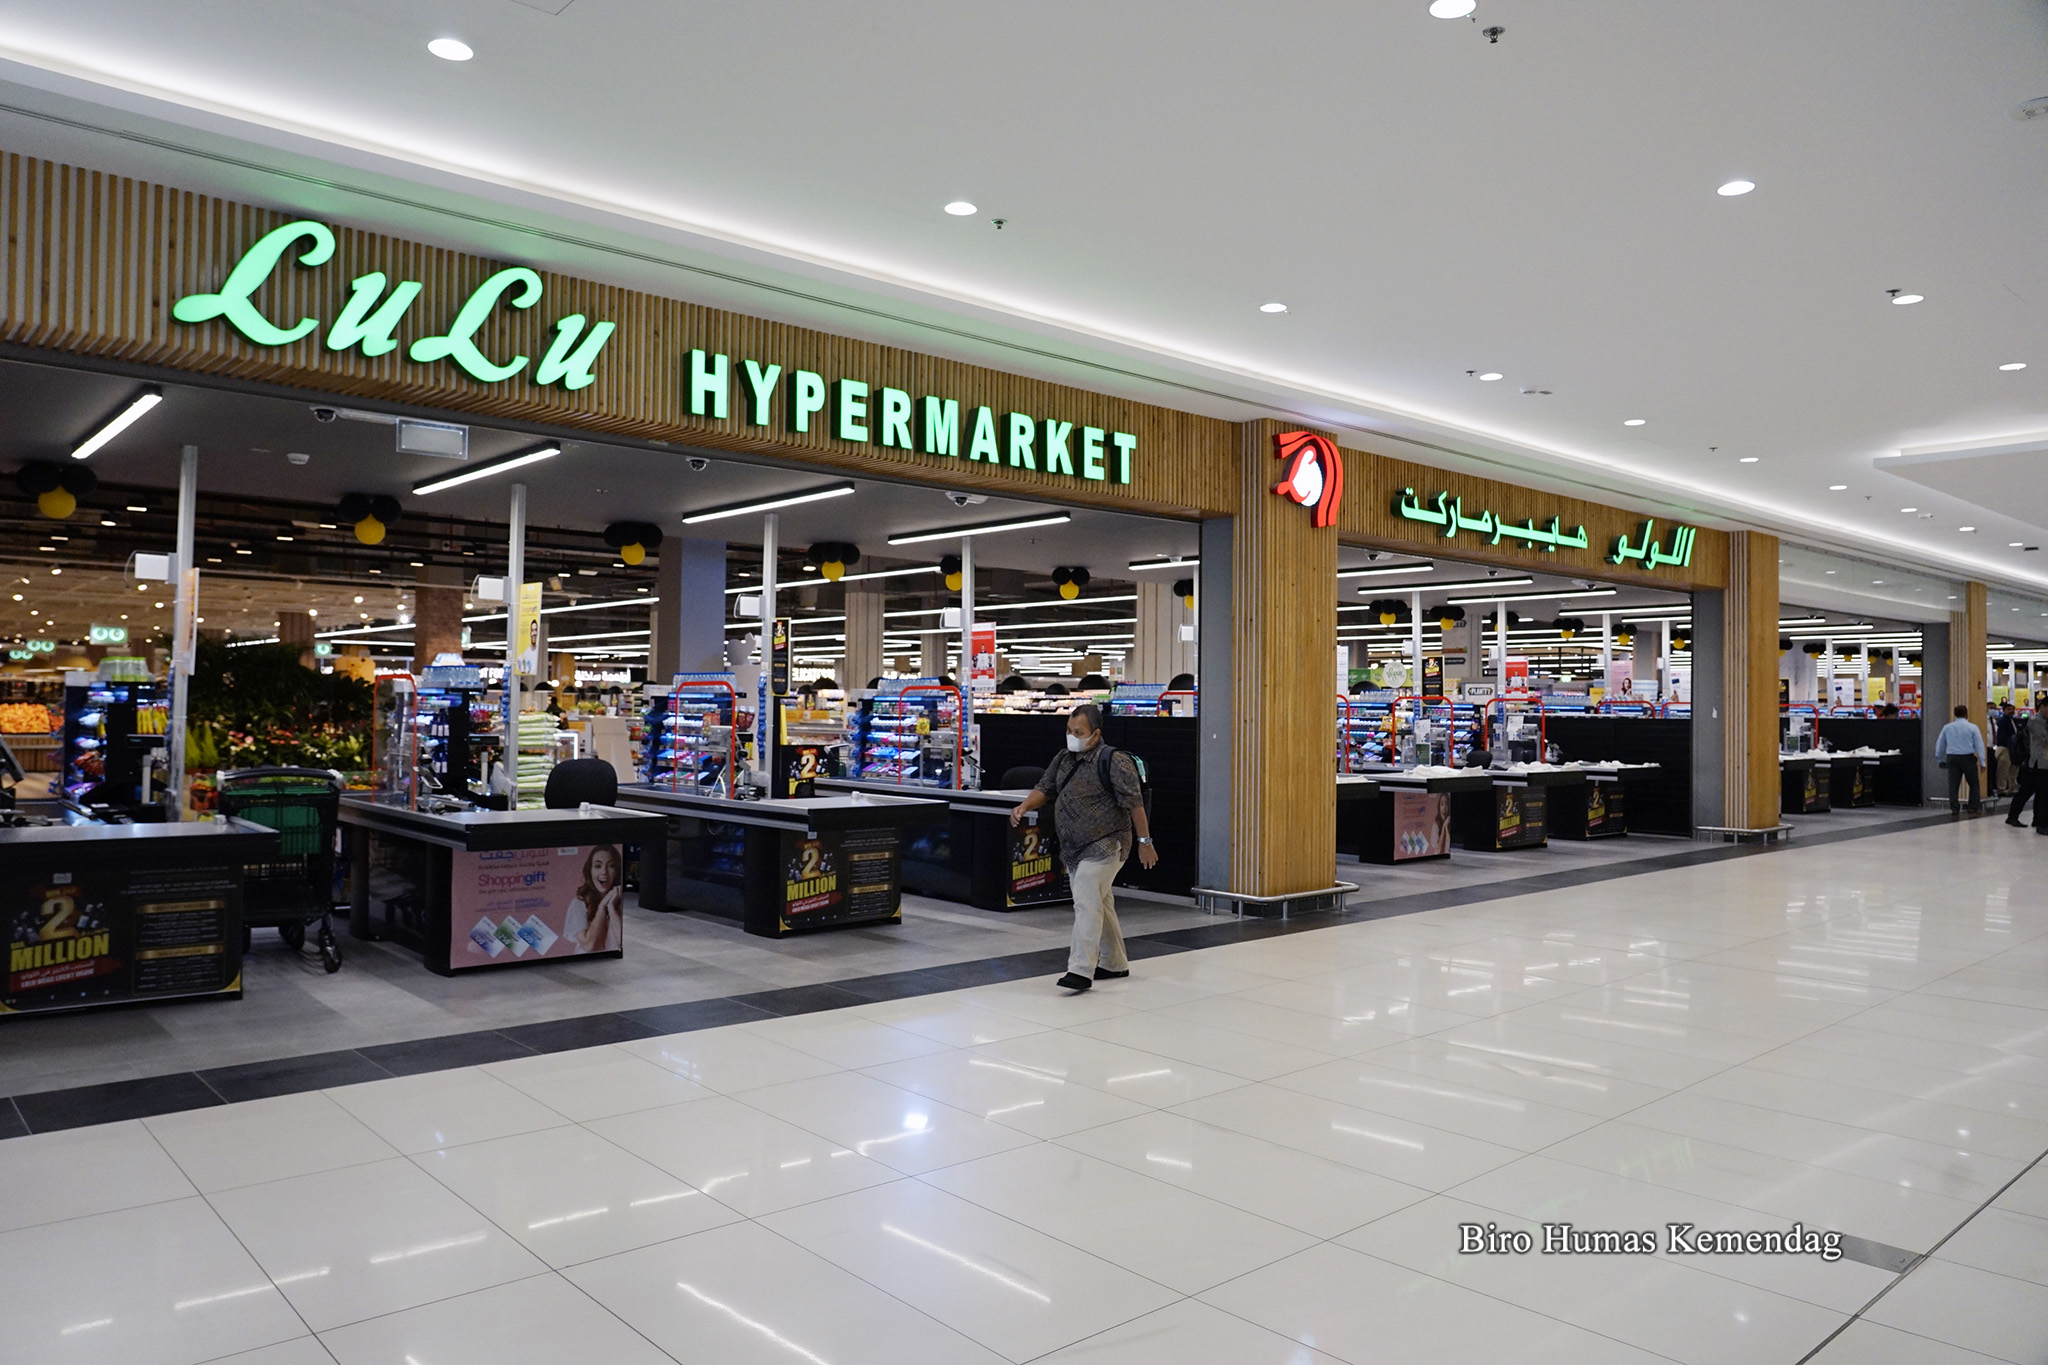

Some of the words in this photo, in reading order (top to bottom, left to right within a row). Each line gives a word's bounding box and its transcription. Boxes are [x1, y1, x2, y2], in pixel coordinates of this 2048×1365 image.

[172, 220, 616, 390] LuLu
[687, 347, 1137, 486] HYPERMARKET
[1399, 486, 1589, 553] هايبرماركت
[1612, 518, 1697, 571] اللولو
[801, 847, 822, 880] 2
[1024, 833, 1039, 861] 2
[478, 871, 547, 888] Shoppingift
[1011, 856, 1052, 881] MILLION
[786, 874, 837, 902] MILLION
[40, 896, 76, 940] 2
[9, 933, 110, 973] MILLION
